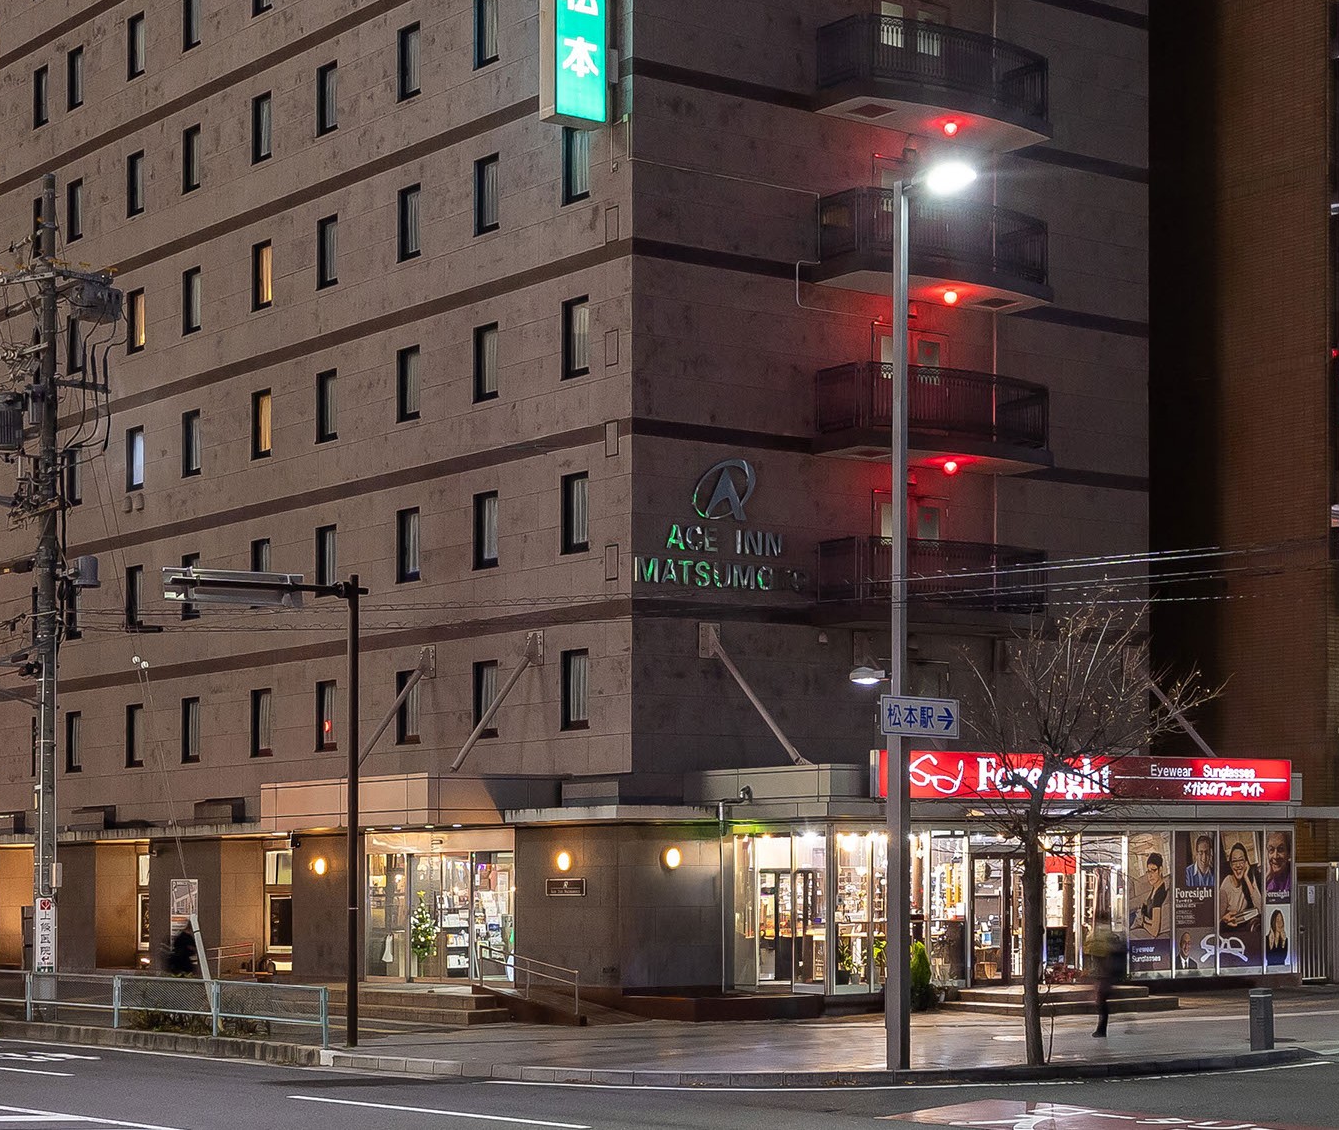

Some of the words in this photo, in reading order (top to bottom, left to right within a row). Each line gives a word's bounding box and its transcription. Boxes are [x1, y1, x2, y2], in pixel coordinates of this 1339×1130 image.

[666, 523, 719, 552] ACE
[735, 529, 782, 557] INN
[634, 556, 807, 593] MATSUMOO
[887, 703, 935, 729] 松本駅
[976, 756, 1110, 801] Foresight
[1150, 764, 1193, 778] Eyewear
[1203, 763, 1255, 779] Sunglasses
[1182, 781, 1265, 797] メガネのフォーサイト
[1175, 887, 1212, 900] Foresight
[1131, 945, 1155, 954] Eyewear
